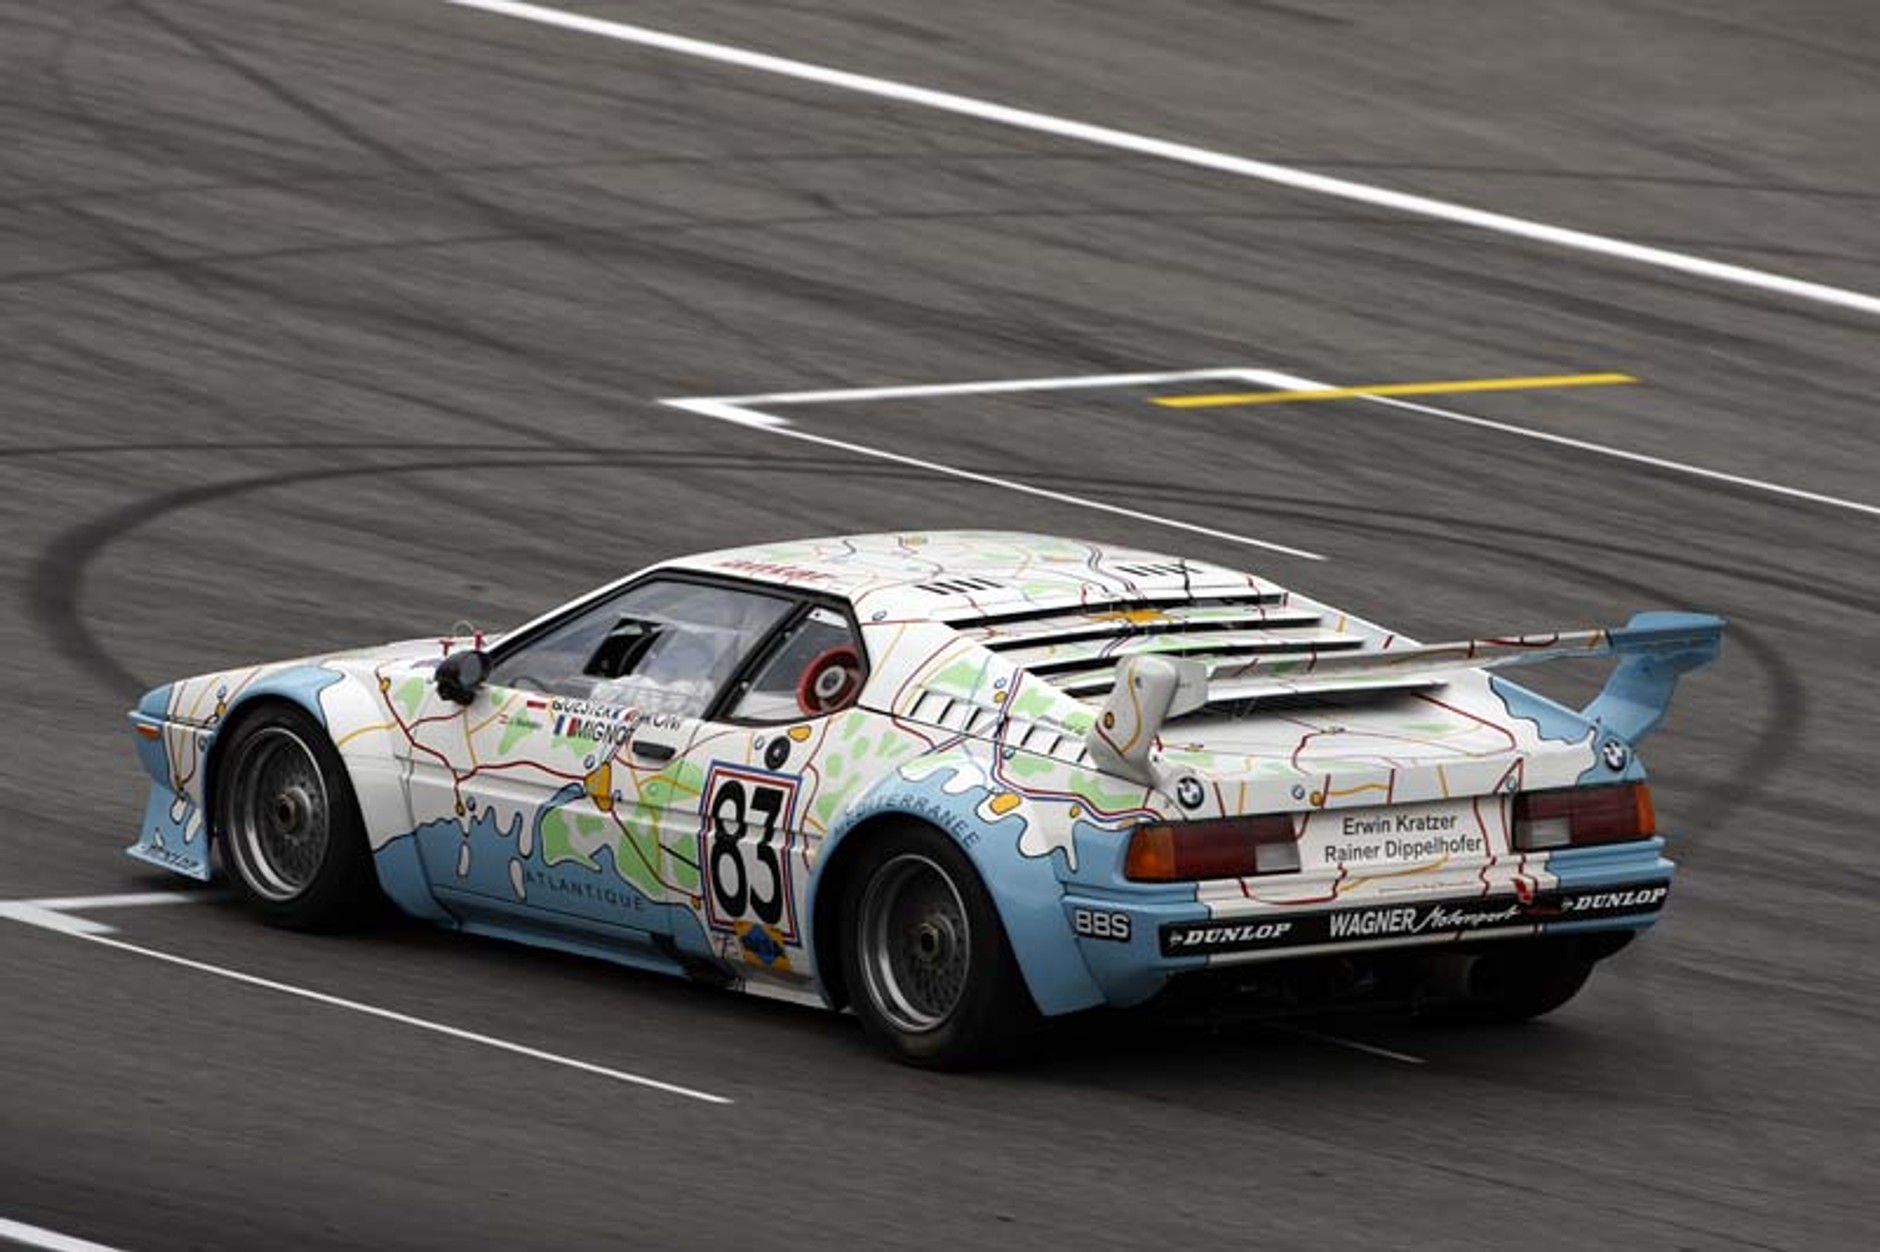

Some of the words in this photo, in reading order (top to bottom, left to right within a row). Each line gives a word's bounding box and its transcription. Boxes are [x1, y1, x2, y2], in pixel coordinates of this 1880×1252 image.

[1343, 816, 1391, 836] Erwin
[1395, 814, 1457, 833] Kratzer
[711, 780, 784, 925] 83
[1325, 843, 1380, 863] Rainer
[1385, 834, 1482, 861] Dippelhofer
[526, 871, 643, 910] ATLANTIQUE
[1575, 887, 1667, 912] DUNLOP
[1075, 909, 1130, 938] BBS
[1181, 922, 1293, 946] DUNLOP
[1329, 907, 1416, 938] WAGNER
